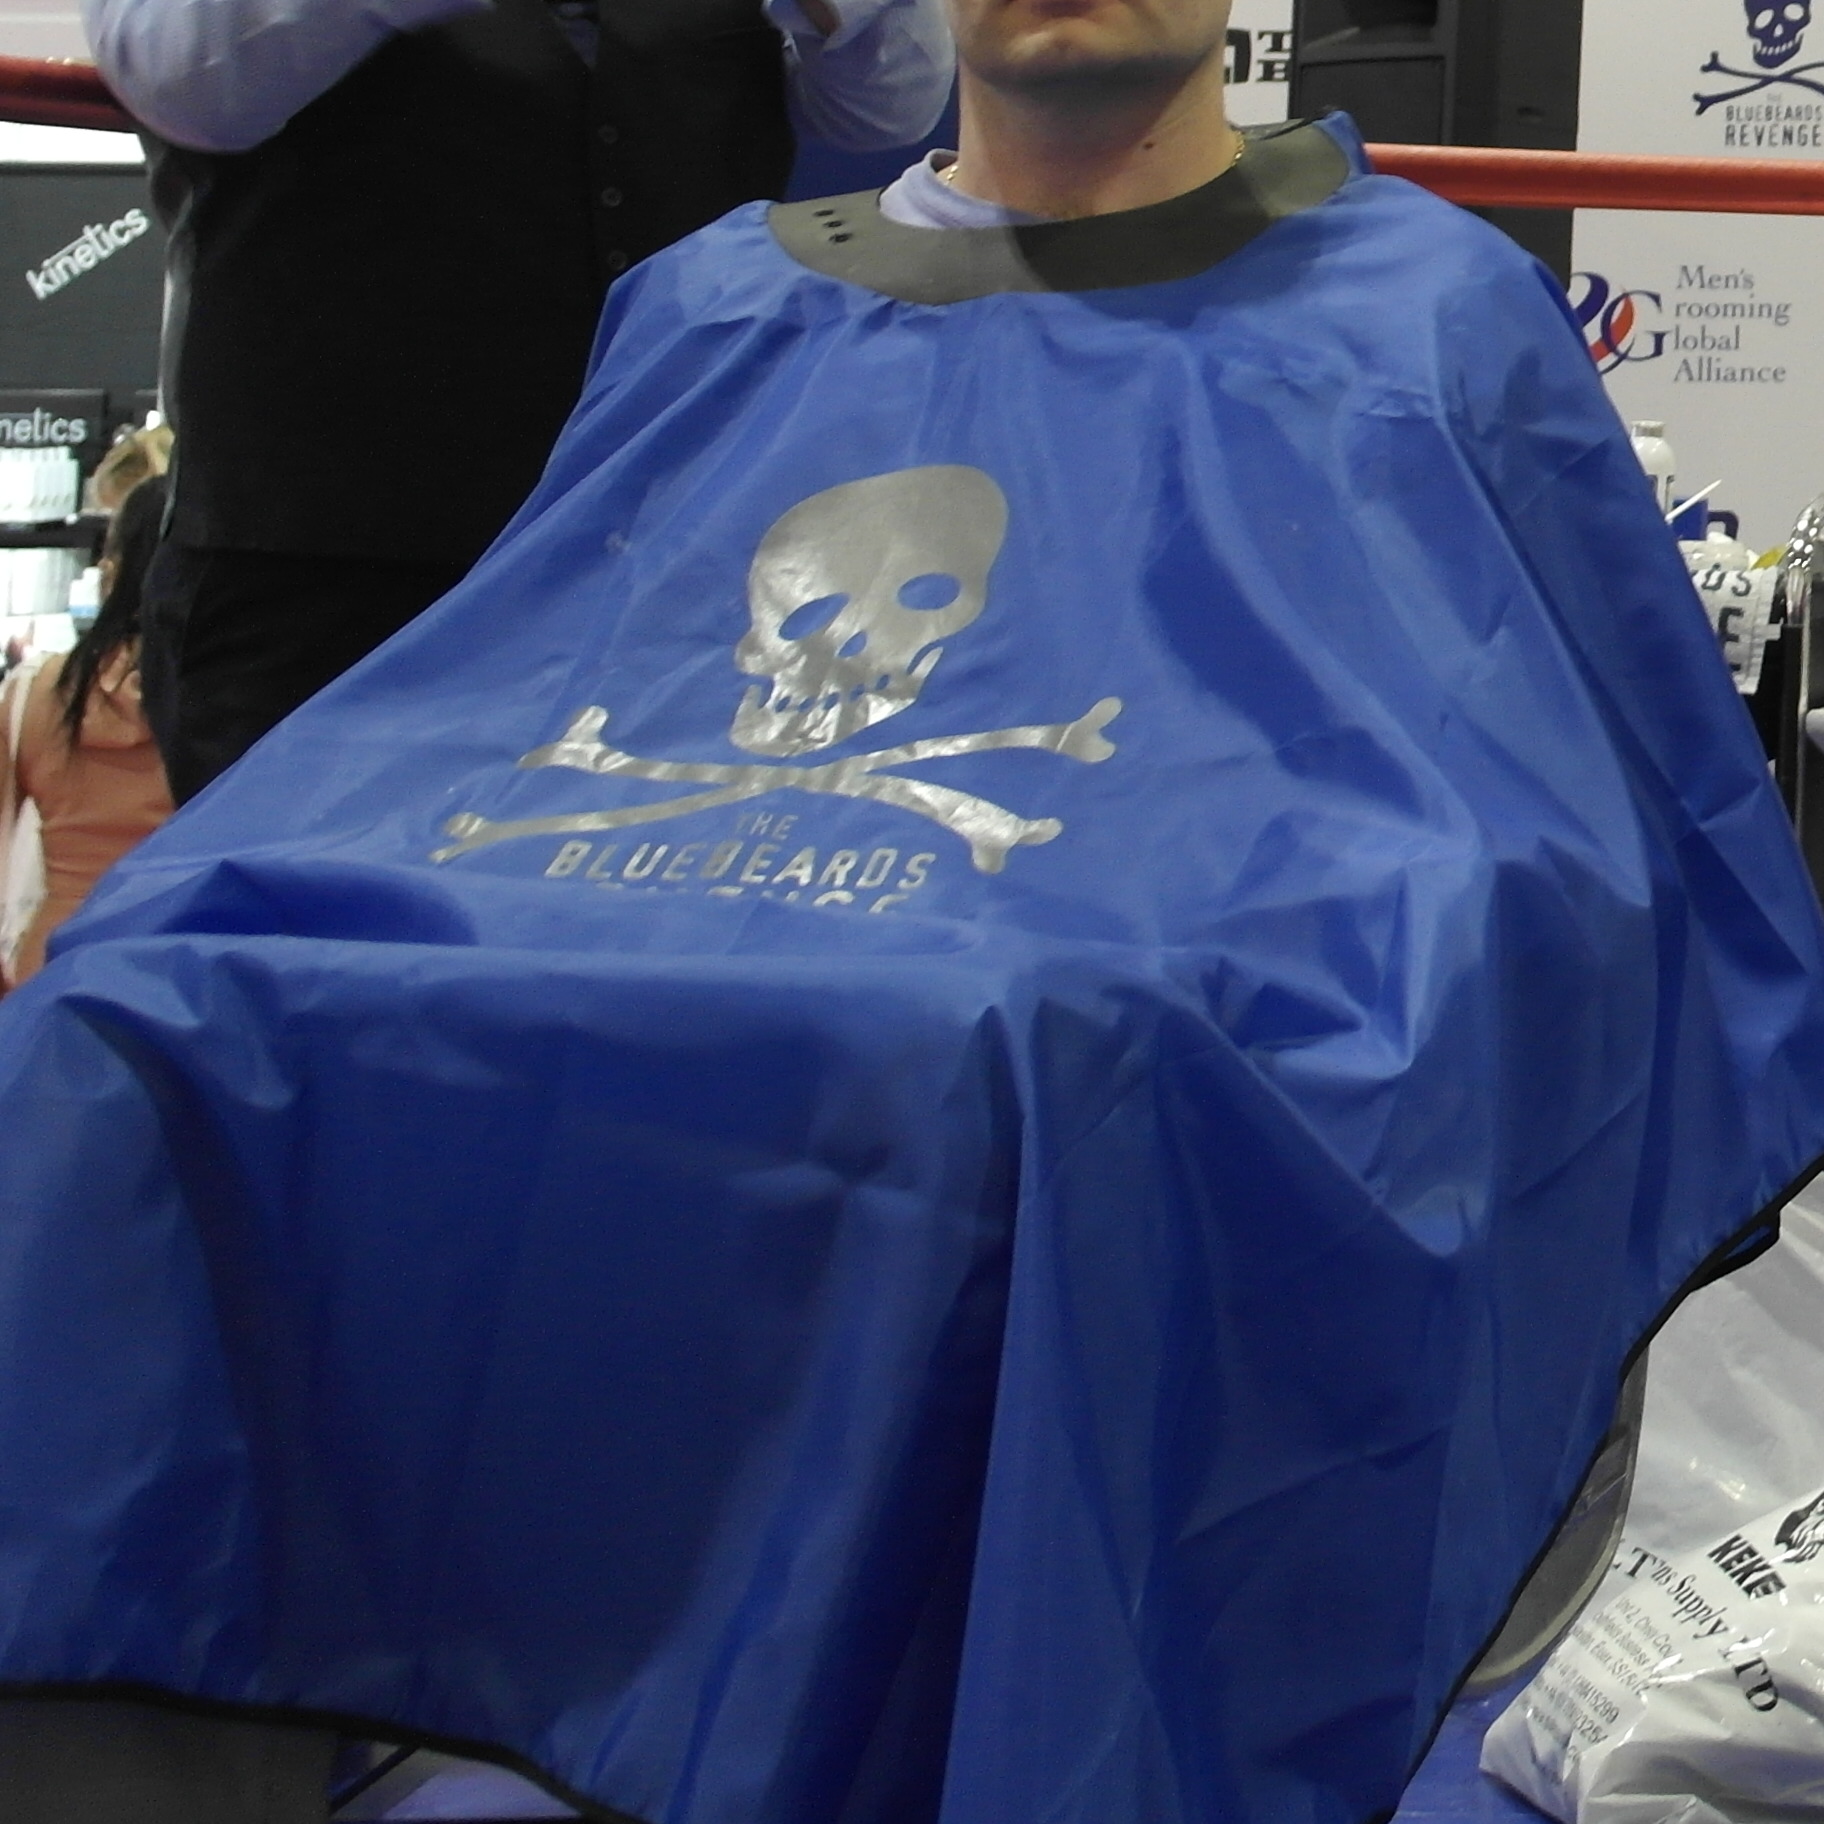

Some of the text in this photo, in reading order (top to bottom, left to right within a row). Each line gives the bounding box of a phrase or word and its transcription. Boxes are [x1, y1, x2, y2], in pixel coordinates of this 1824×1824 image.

[1725, 105, 1822, 121] BLUEBEARDS
[1725, 124, 1822, 147] REVENGE
[26, 208, 151, 300] kinetics
[1676, 265, 1754, 289] Men's
[1673, 357, 1786, 383] Alliance
[0, 408, 87, 443] netics
[736, 812, 798, 841] THE
[544, 840, 936, 890] BLUEBEARDS
[1707, 1533, 1787, 1599] KEKE
[1668, 1573, 1731, 1640] Supply
